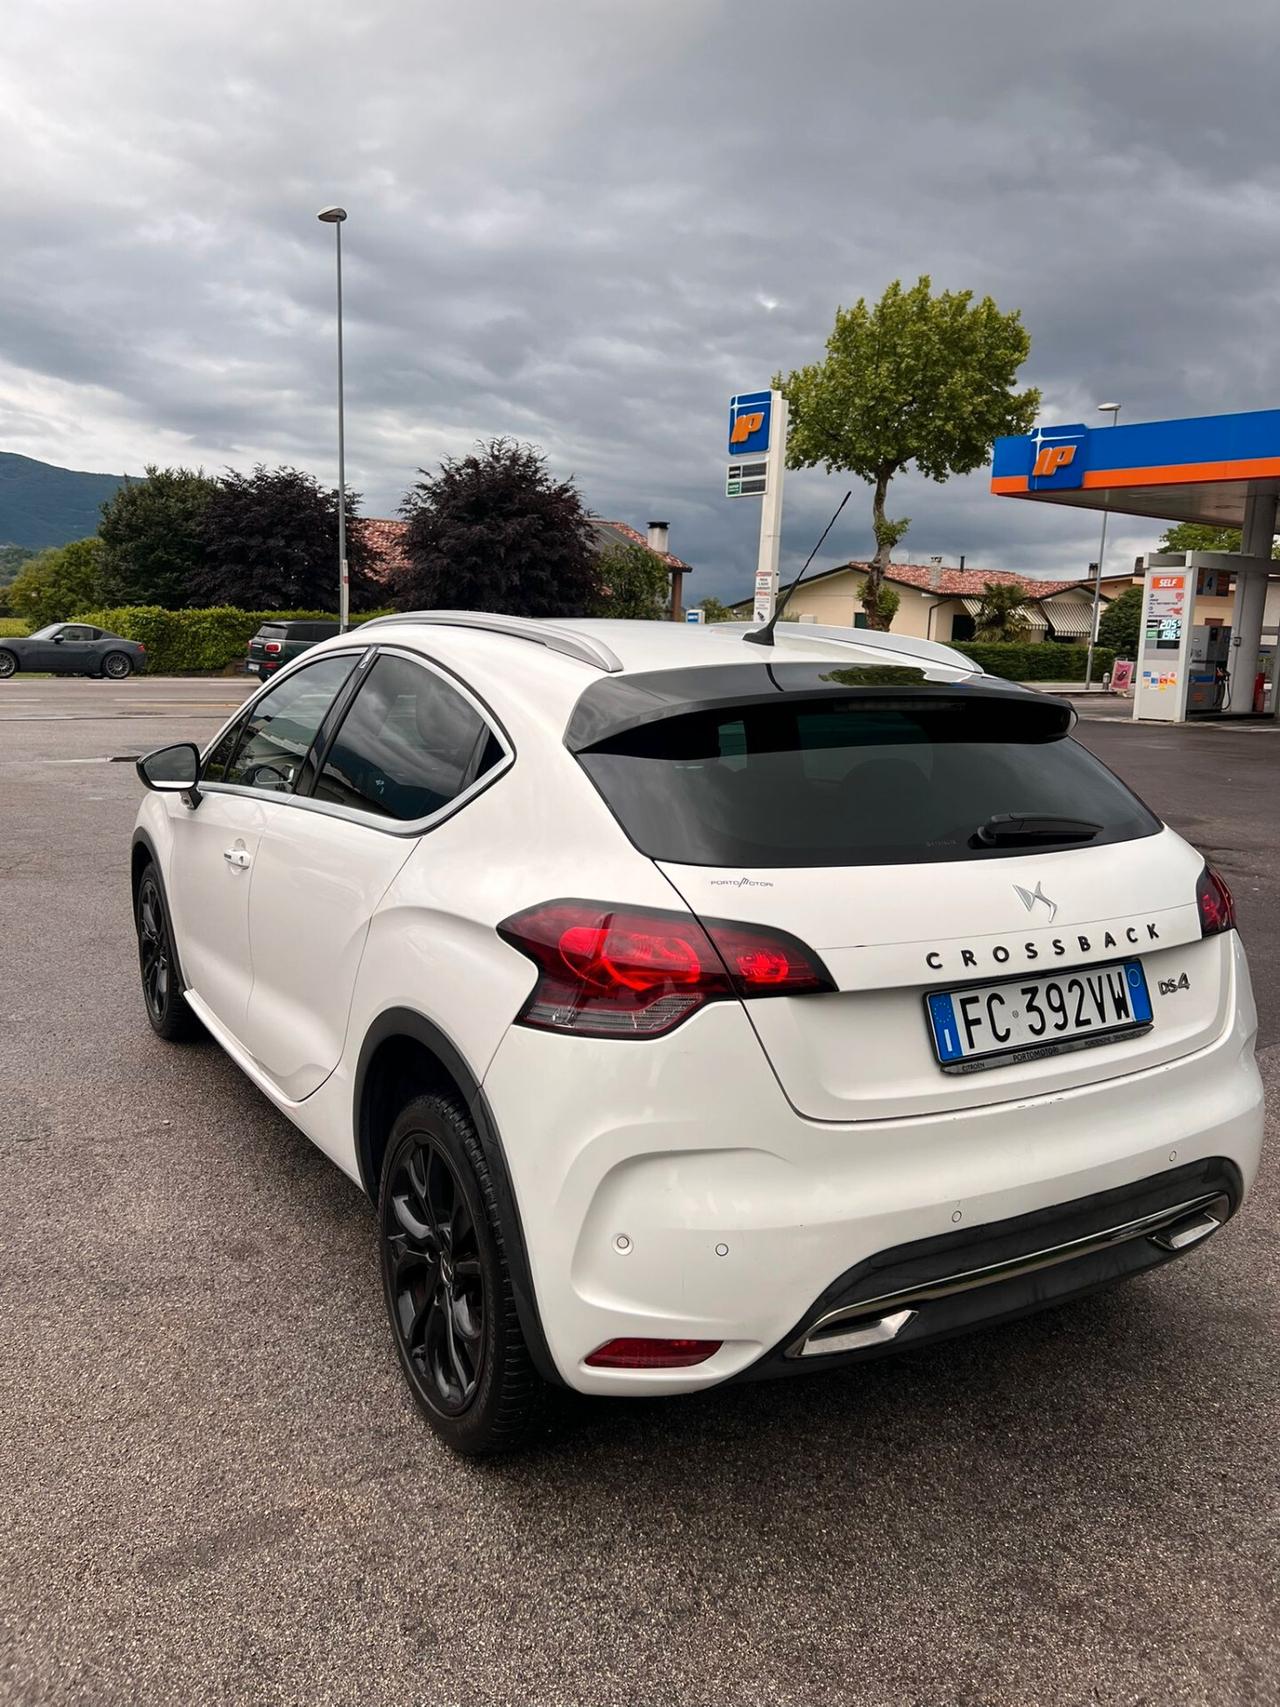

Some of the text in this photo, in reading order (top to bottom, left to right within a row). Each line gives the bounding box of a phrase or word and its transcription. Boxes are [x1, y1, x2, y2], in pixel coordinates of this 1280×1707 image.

[730, 412, 765, 443] IP
[1032, 445, 1077, 476] IP
[1159, 578, 1177, 587] SELF
[926, 923, 1160, 970] CROSSBACK
[1158, 972, 1191, 995] DS4
